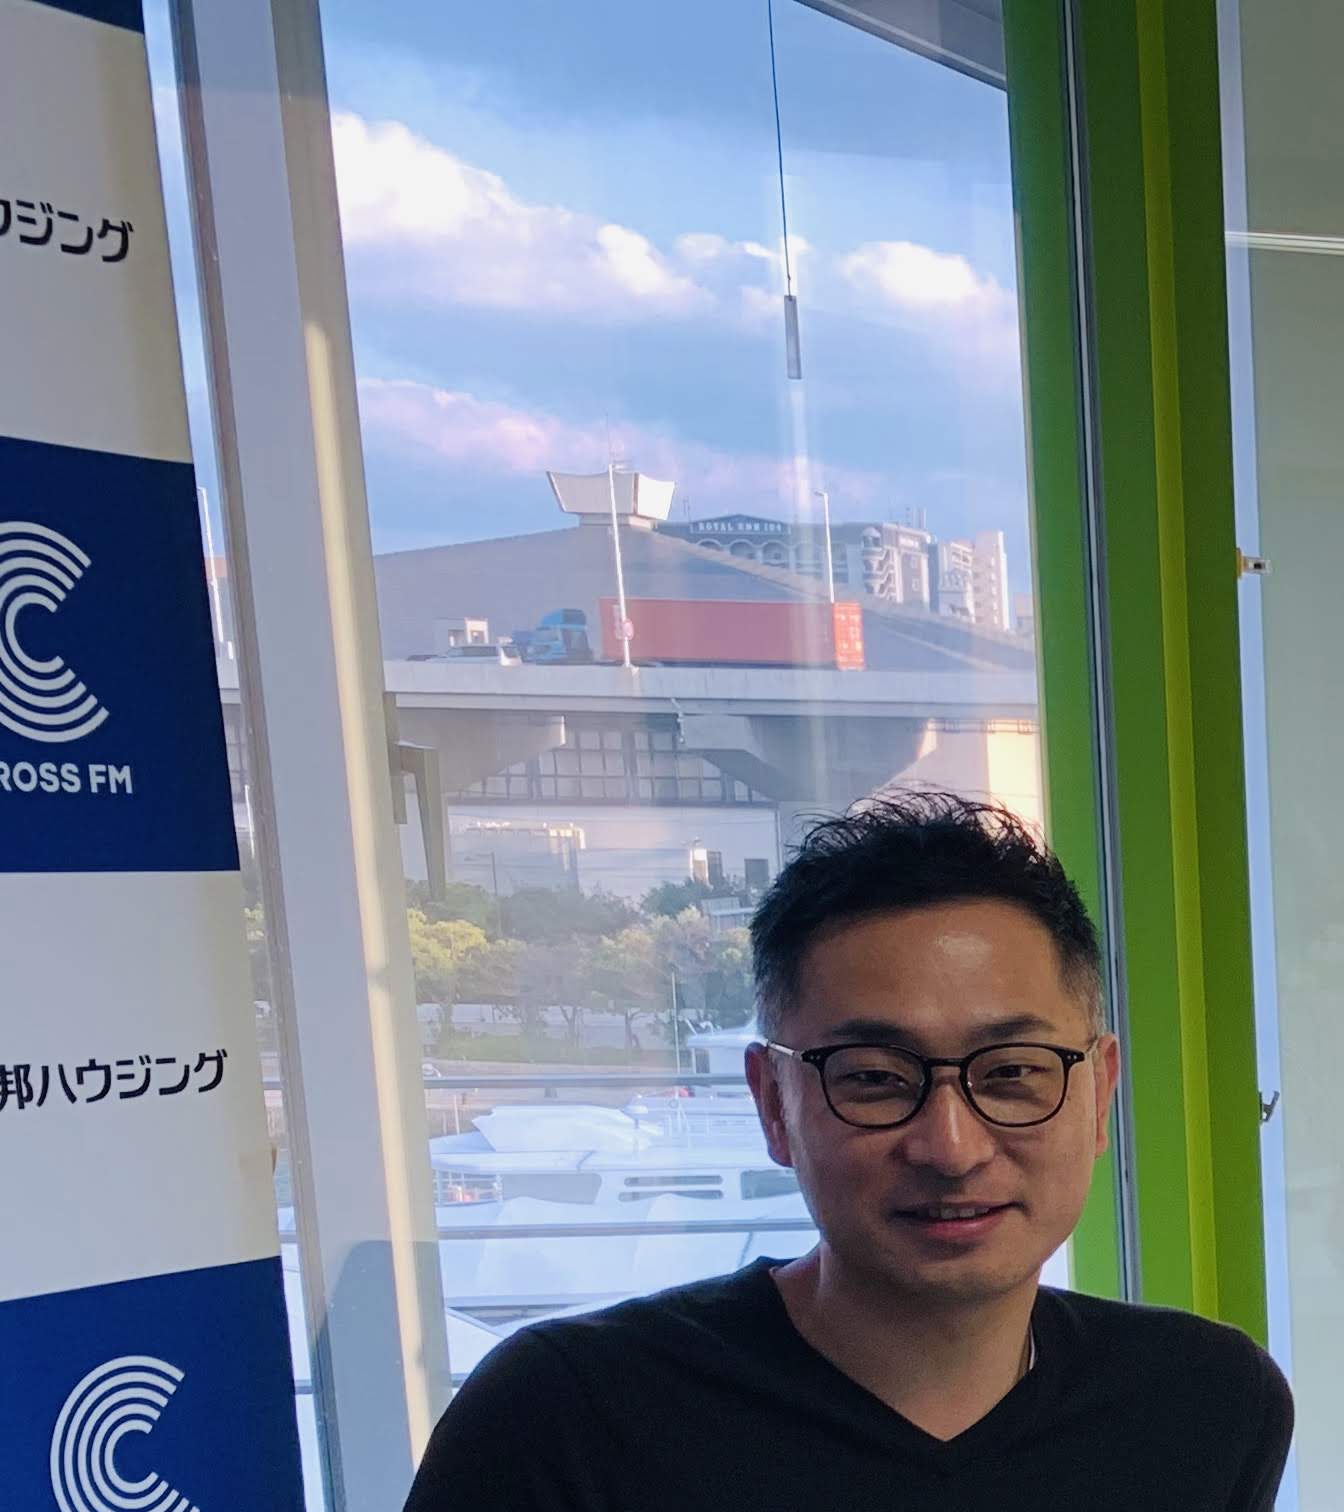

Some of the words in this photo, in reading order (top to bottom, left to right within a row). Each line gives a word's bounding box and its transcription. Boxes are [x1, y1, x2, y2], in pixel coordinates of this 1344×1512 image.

[88, 764, 133, 794] FM
[0, 1049, 228, 1112] 邦ハウジング
